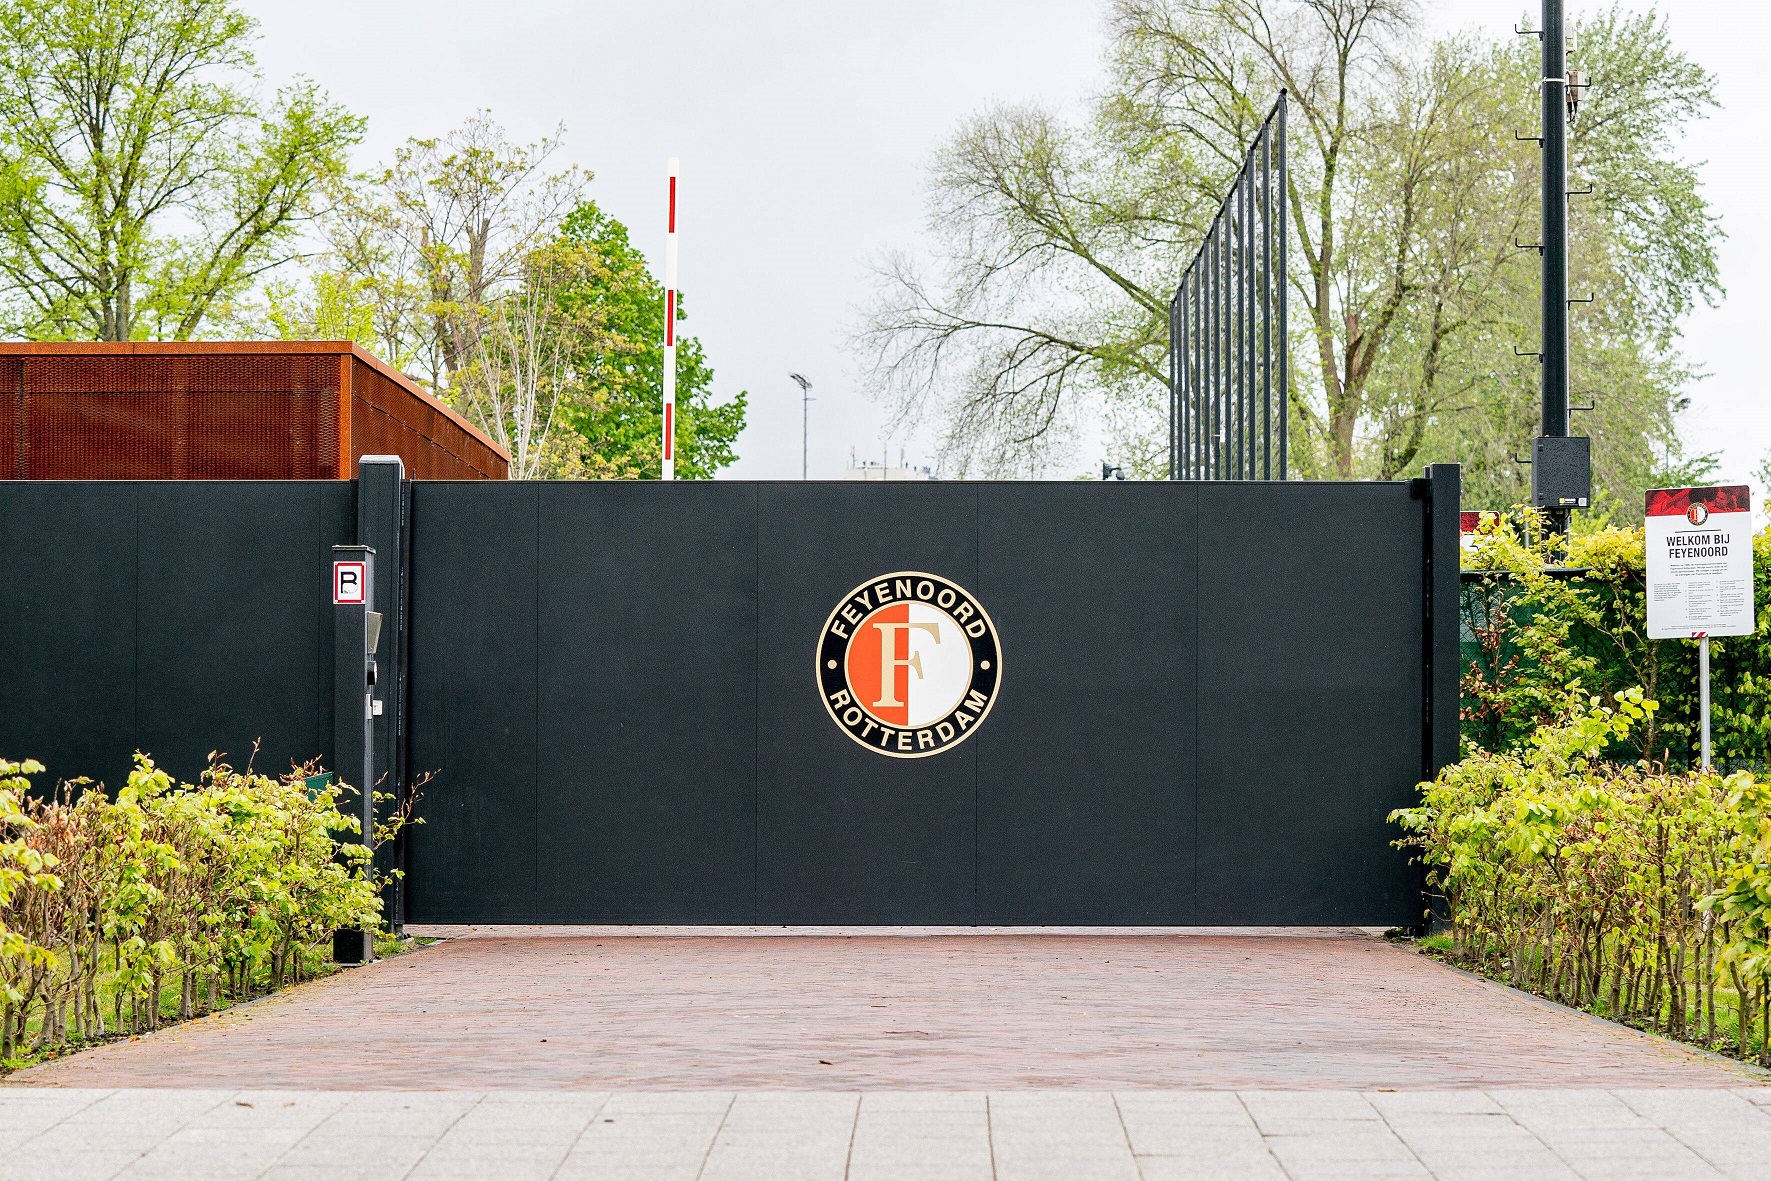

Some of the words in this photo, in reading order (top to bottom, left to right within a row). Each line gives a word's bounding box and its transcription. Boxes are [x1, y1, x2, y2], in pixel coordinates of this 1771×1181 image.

[1666, 535, 1710, 546] WELKOM
[1714, 534, 1730, 544] BIJ
[1669, 546, 1728, 558] FEYENOORD
[831, 579, 986, 639] FEYENOORD
[873, 622, 940, 707] F
[830, 689, 988, 750] ROTTERDAM
